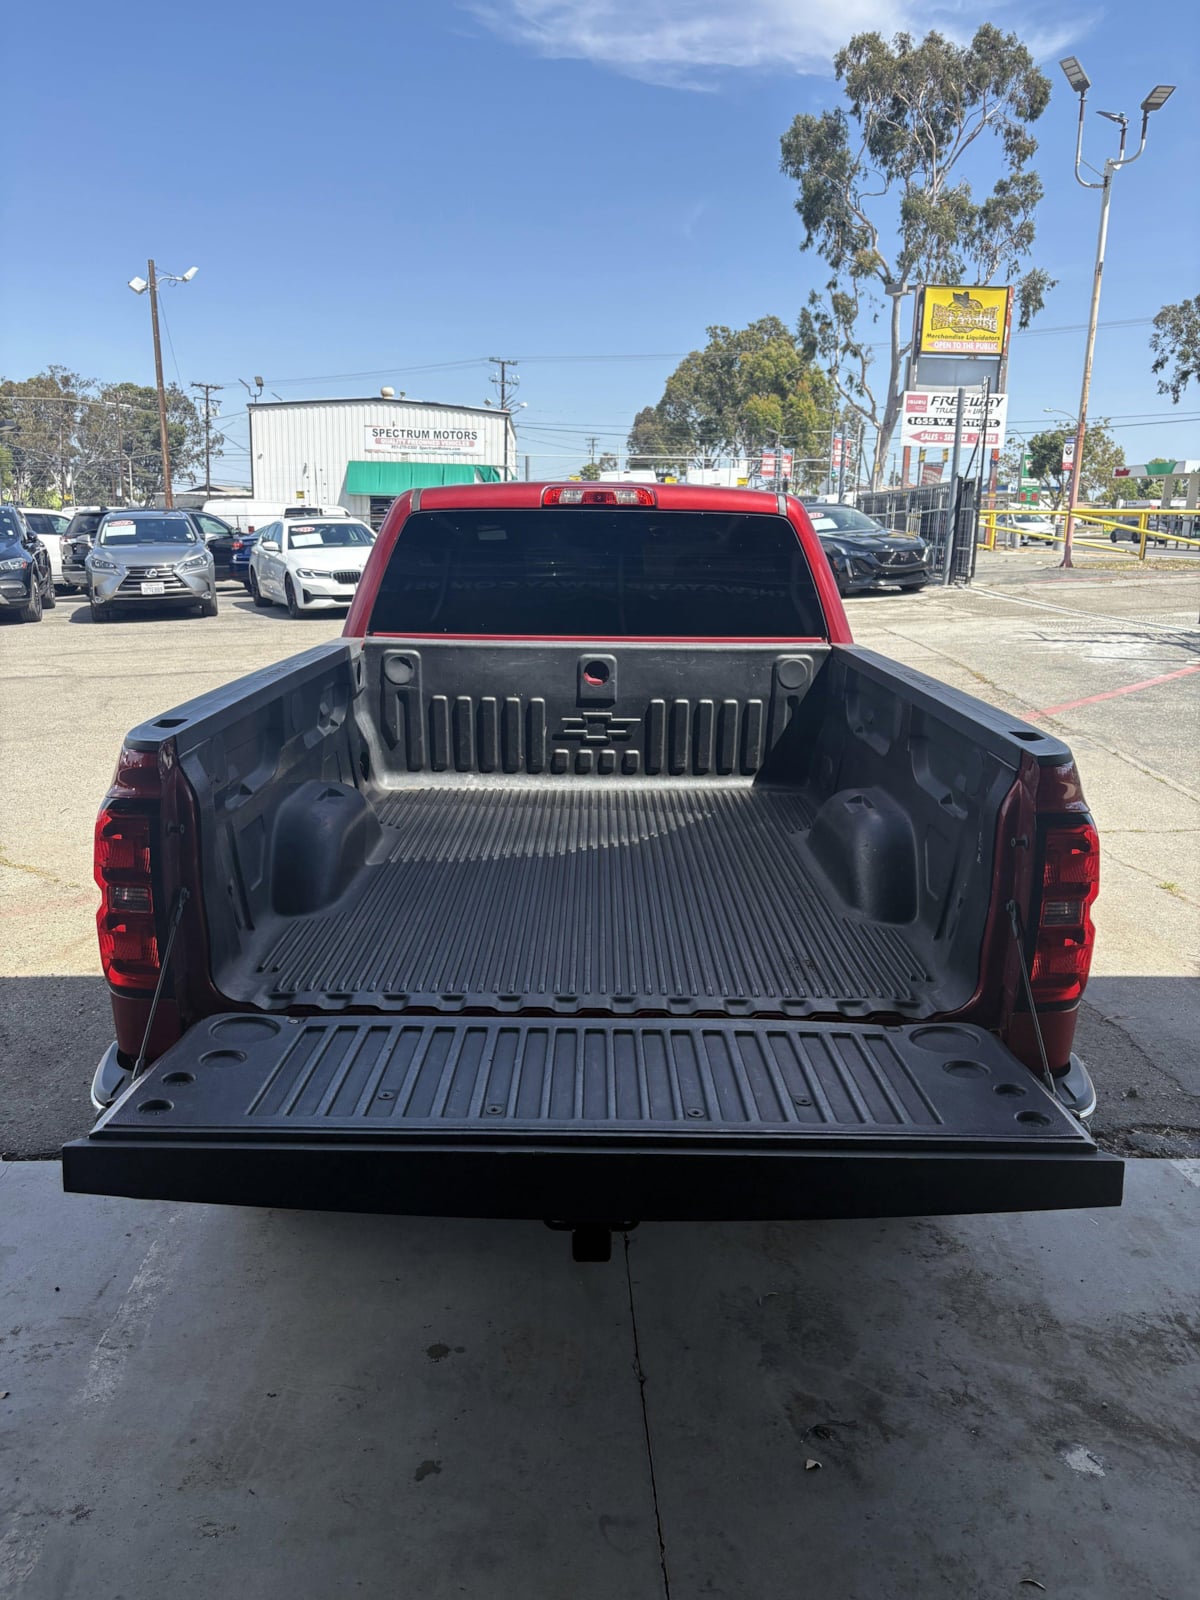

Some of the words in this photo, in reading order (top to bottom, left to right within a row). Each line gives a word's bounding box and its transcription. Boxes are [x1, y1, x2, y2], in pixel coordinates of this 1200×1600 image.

[935, 341, 952, 349] OPEN
[952, 341, 962, 349] TO
[963, 342, 975, 350] THE
[975, 342, 998, 350] PUBLIC
[910, 417, 935, 425] 1655
[937, 418, 949, 426] W.
[951, 418, 981, 427] SXTH
[372, 428, 430, 439] SPECTRUM
[433, 430, 478, 440] MOTORS
[920, 433, 939, 441] SALES
